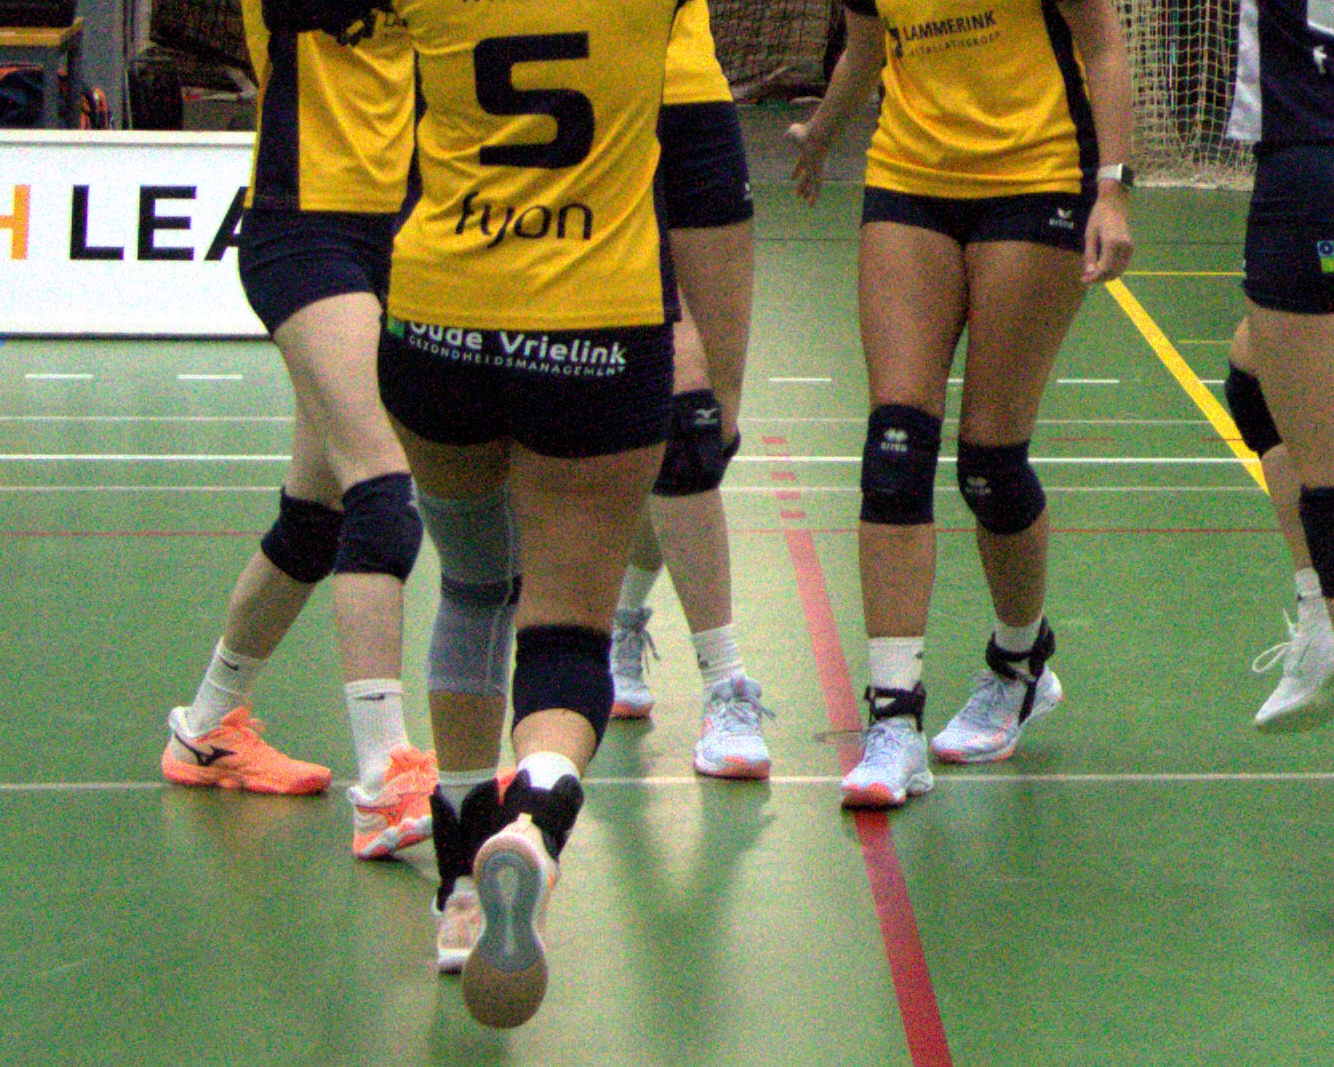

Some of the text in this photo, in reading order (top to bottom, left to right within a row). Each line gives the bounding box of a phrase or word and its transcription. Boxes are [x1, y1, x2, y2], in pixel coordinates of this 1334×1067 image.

[902, 10, 997, 41] LAMMERINK
[473, 31, 596, 169] 5
[455, 191, 594, 248] fyon
[499, 332, 627, 365] Vrielink
